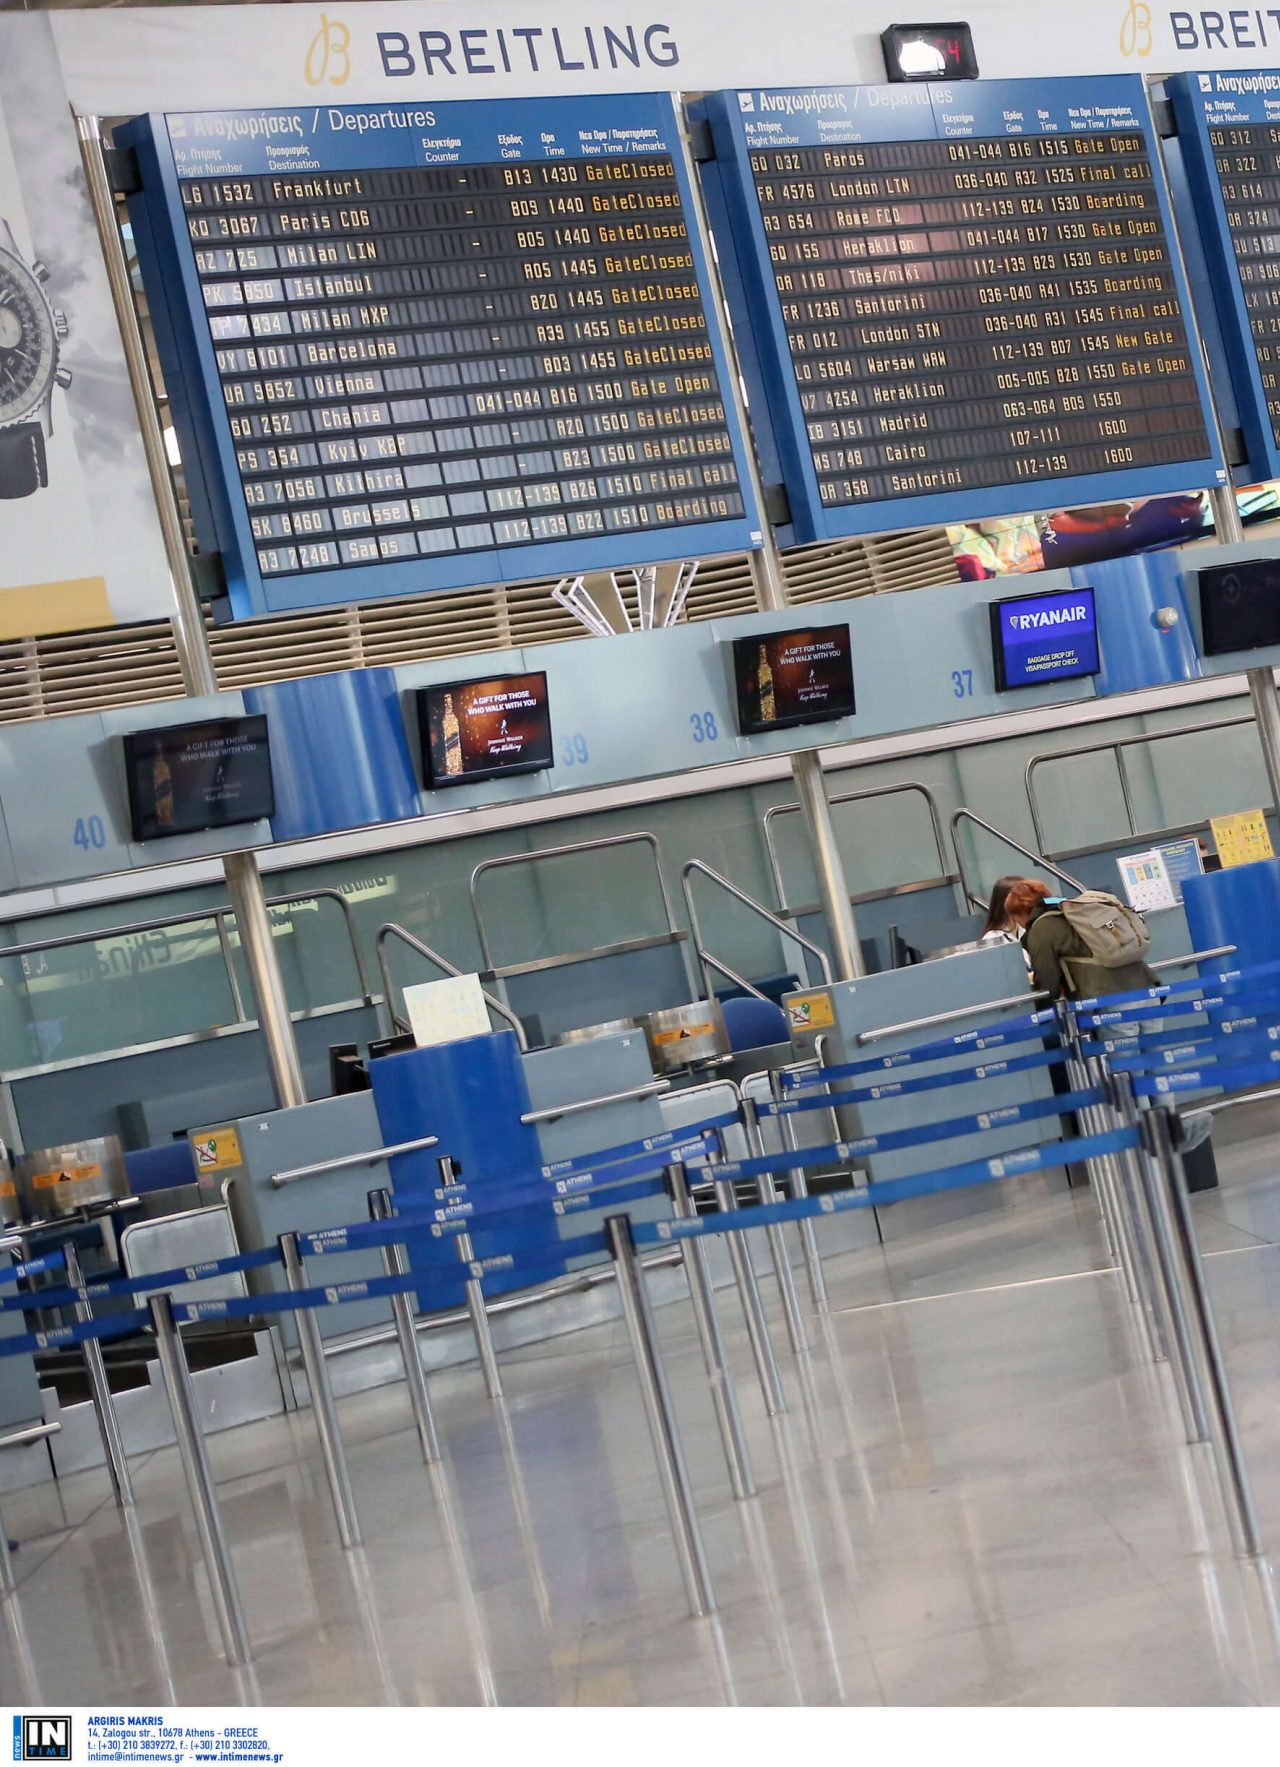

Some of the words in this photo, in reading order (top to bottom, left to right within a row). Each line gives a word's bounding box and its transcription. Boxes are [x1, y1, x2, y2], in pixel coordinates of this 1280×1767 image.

[376, 24, 680, 77] BREITLING
[760, 90, 846, 114] Αναχωρήσεις
[867, 87, 953, 110] Departures
[194, 113, 304, 140] Αναχωρήσεις
[328, 109, 436, 134] Departures
[425, 151, 460, 163] Counter
[501, 148, 521, 159] Gate
[543, 146, 565, 156] Time
[581, 143, 600, 155] New
[602, 143, 623, 153] Time
[631, 141, 667, 152] Remarks
[177, 165, 204, 176] Flight
[206, 162, 243, 174] Number
[269, 159, 320, 171] Destination
[213, 184, 254, 202] 1532
[272, 178, 363, 199] Frankfurt
[543, 166, 579, 183] 1430
[585, 161, 674, 181] GateClosed
[757, 185, 775, 201] FR
[781, 183, 815, 199] 4576
[829, 179, 879, 197] London
[885, 178, 910, 193] LTN
[954, 172, 1008, 189] 036-040
[1046, 168, 1075, 183] 1525
[1079, 166, 1115, 181] Final
[1121, 164, 1150, 179] call
[218, 217, 261, 235] 3067
[279, 212, 330, 232] Paris
[549, 197, 586, 214] 1440
[591, 191, 680, 212] GateClosed
[286, 245, 337, 264] Milan
[345, 242, 376, 260] LIN
[556, 228, 592, 246] 1440
[597, 222, 686, 243] GateClosed
[781, 304, 799, 320] FR
[807, 301, 840, 318] 1236
[854, 294, 926, 314] Santorini
[978, 285, 1032, 303] 036-040
[1069, 279, 1099, 295] 1535
[1102, 274, 1161, 294] Boarding
[306, 339, 396, 363] Barcelona
[575, 321, 611, 339] 1455
[616, 313, 705, 336] GateClosed
[818, 360, 852, 378] 5604
[866, 354, 915, 373] Warsaw
[991, 342, 1043, 361] 112-139
[1081, 335, 1111, 352] 1545
[1114, 333, 1137, 348] New
[1142, 329, 1172, 345] Gate
[260, 415, 292, 434] 252
[320, 407, 381, 428] Chania
[474, 391, 541, 413] 041-044
[588, 383, 624, 402] 1500
[629, 379, 666, 397] Gate
[673, 375, 709, 395] Open
[830, 420, 863, 438] 3151
[878, 413, 927, 432] Madrid
[1002, 398, 1055, 418] 063-064
[1093, 391, 1122, 408] 1550
[340, 502, 420, 527] Brussels
[607, 476, 643, 495] 1510
[648, 470, 692, 490] Final
[700, 465, 735, 484] call
[1020, 605, 1087, 630] RYANAIR
[1027, 652, 1051, 664] BAGGAGE
[1051, 651, 1065, 660] DROP
[1065, 650, 1075, 658] OFF
[1061, 657, 1079, 667] CHECK
[478, 695, 494, 705] GIFT
[494, 693, 508, 702] FOR
[508, 690, 530, 700] THOSE
[951, 669, 973, 698] 37
[467, 706, 485, 716] WHO
[485, 703, 505, 713] WALK
[504, 701, 523, 710] WITH
[522, 698, 537, 708] YOU
[690, 711, 718, 743] 38
[560, 733, 589, 767] 39
[73, 815, 107, 851] 40
[565, 1174, 592, 1186] ATHENS
[445, 1202, 473, 1215] ATHENS
